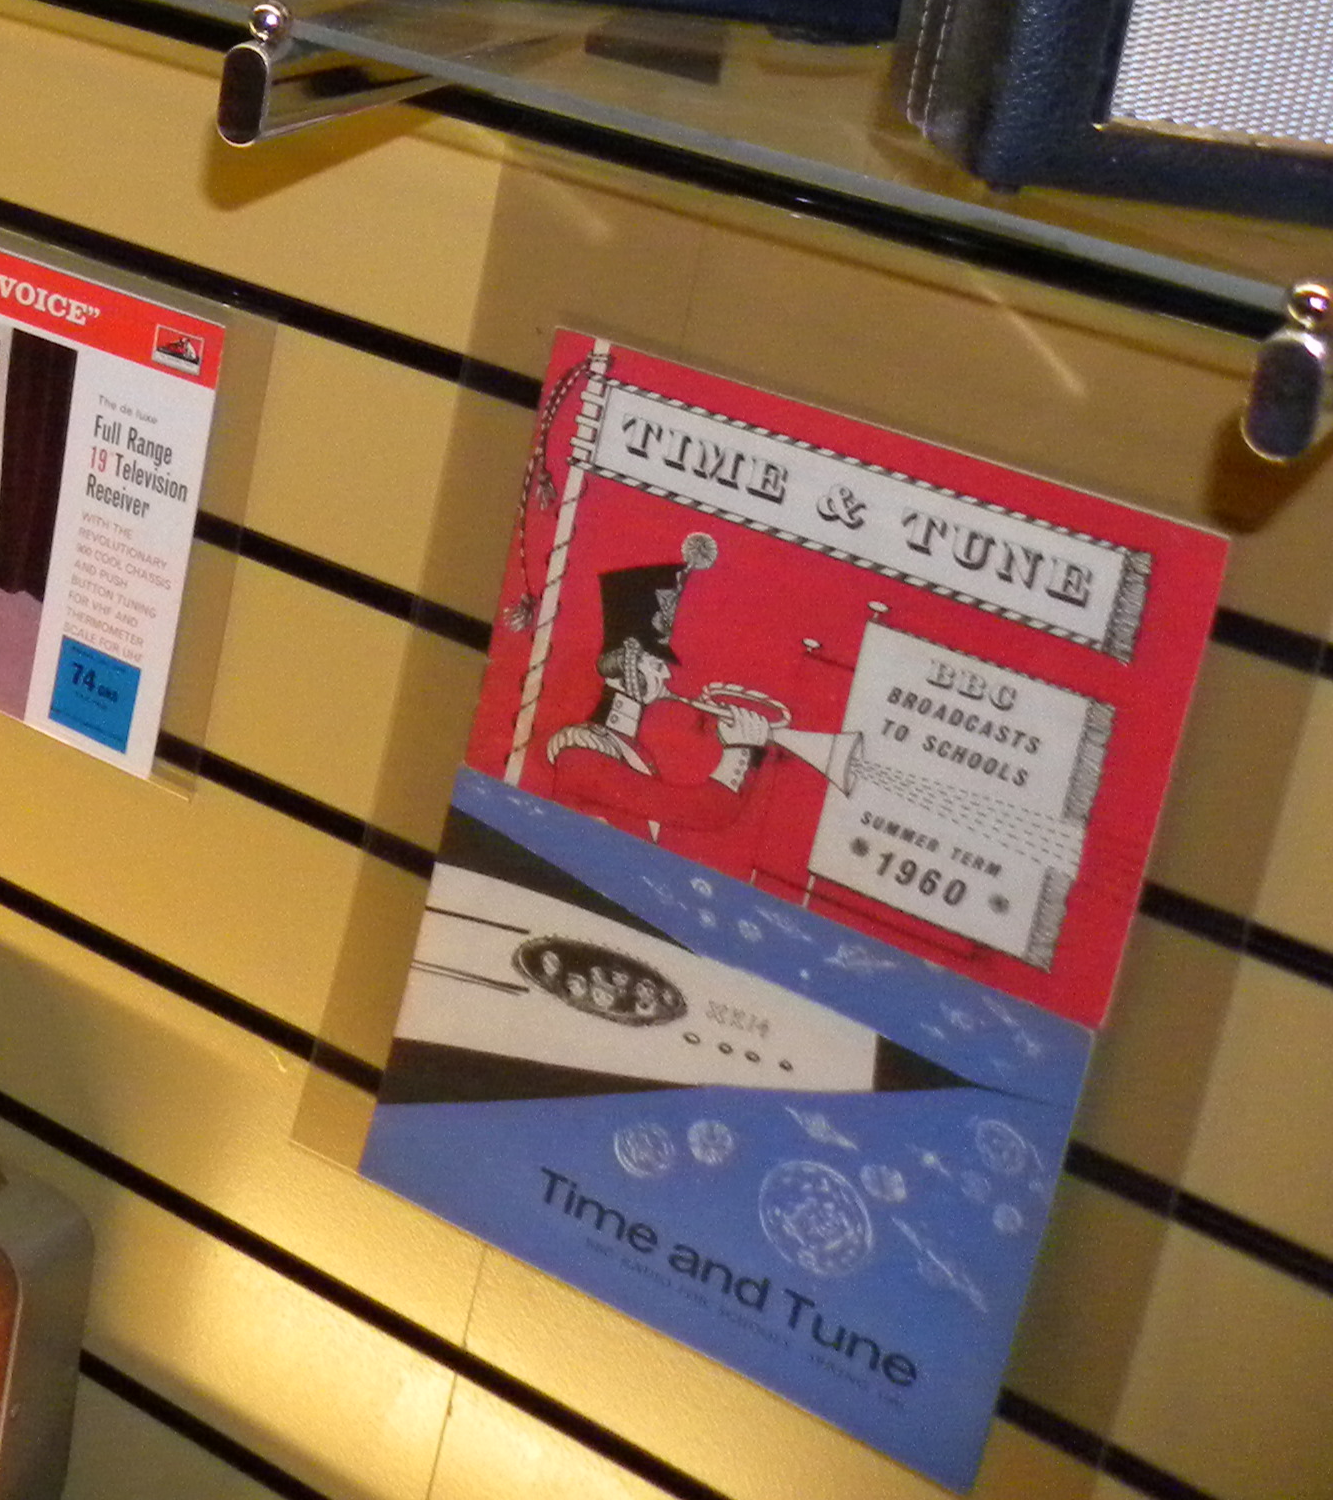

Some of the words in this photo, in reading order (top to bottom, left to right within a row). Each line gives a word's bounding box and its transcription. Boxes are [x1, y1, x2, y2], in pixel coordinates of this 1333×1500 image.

[99, 394, 117, 411] The
[119, 402, 133, 416] de
[135, 409, 158, 426] luxe
[94, 414, 122, 446] Full
[127, 426, 173, 468] Range
[86, 473, 150, 518] Receiver
[115, 451, 188, 503] Television
[82, 511, 110, 530] WITH
[113, 521, 133, 540] THE
[621, 412, 790, 505] TIME
[816, 484, 865, 531] &
[901, 506, 1094, 610] TUNE
[78, 526, 168, 570] REVOLUTIONARY
[94, 549, 123, 572] COOL
[124, 562, 172, 591] CHASSIS
[71, 573, 114, 602] BUTTON
[116, 593, 157, 620] TUNING
[74, 560, 97, 578] AND
[99, 568, 129, 590] PUSH
[66, 605, 145, 649] THERMOMETER
[68, 590, 91, 609] FOR
[92, 600, 113, 618] VHF
[115, 610, 139, 630] AND
[63, 621, 96, 644] SCALE
[99, 635, 122, 655] FOR
[70, 661, 97, 694] 74
[925, 658, 1017, 712] BBC
[886, 686, 1042, 755] BROADCASTS
[880, 718, 910, 743] TO
[922, 734, 1029, 788] SCHOOLS
[859, 810, 940, 853] SUMMER
[949, 846, 1003, 878] TERM
[876, 851, 968, 907] 1960
[539, 1166, 658, 1255] Time
[667, 1242, 771, 1313] and
[783, 1287, 918, 1388] Tune
